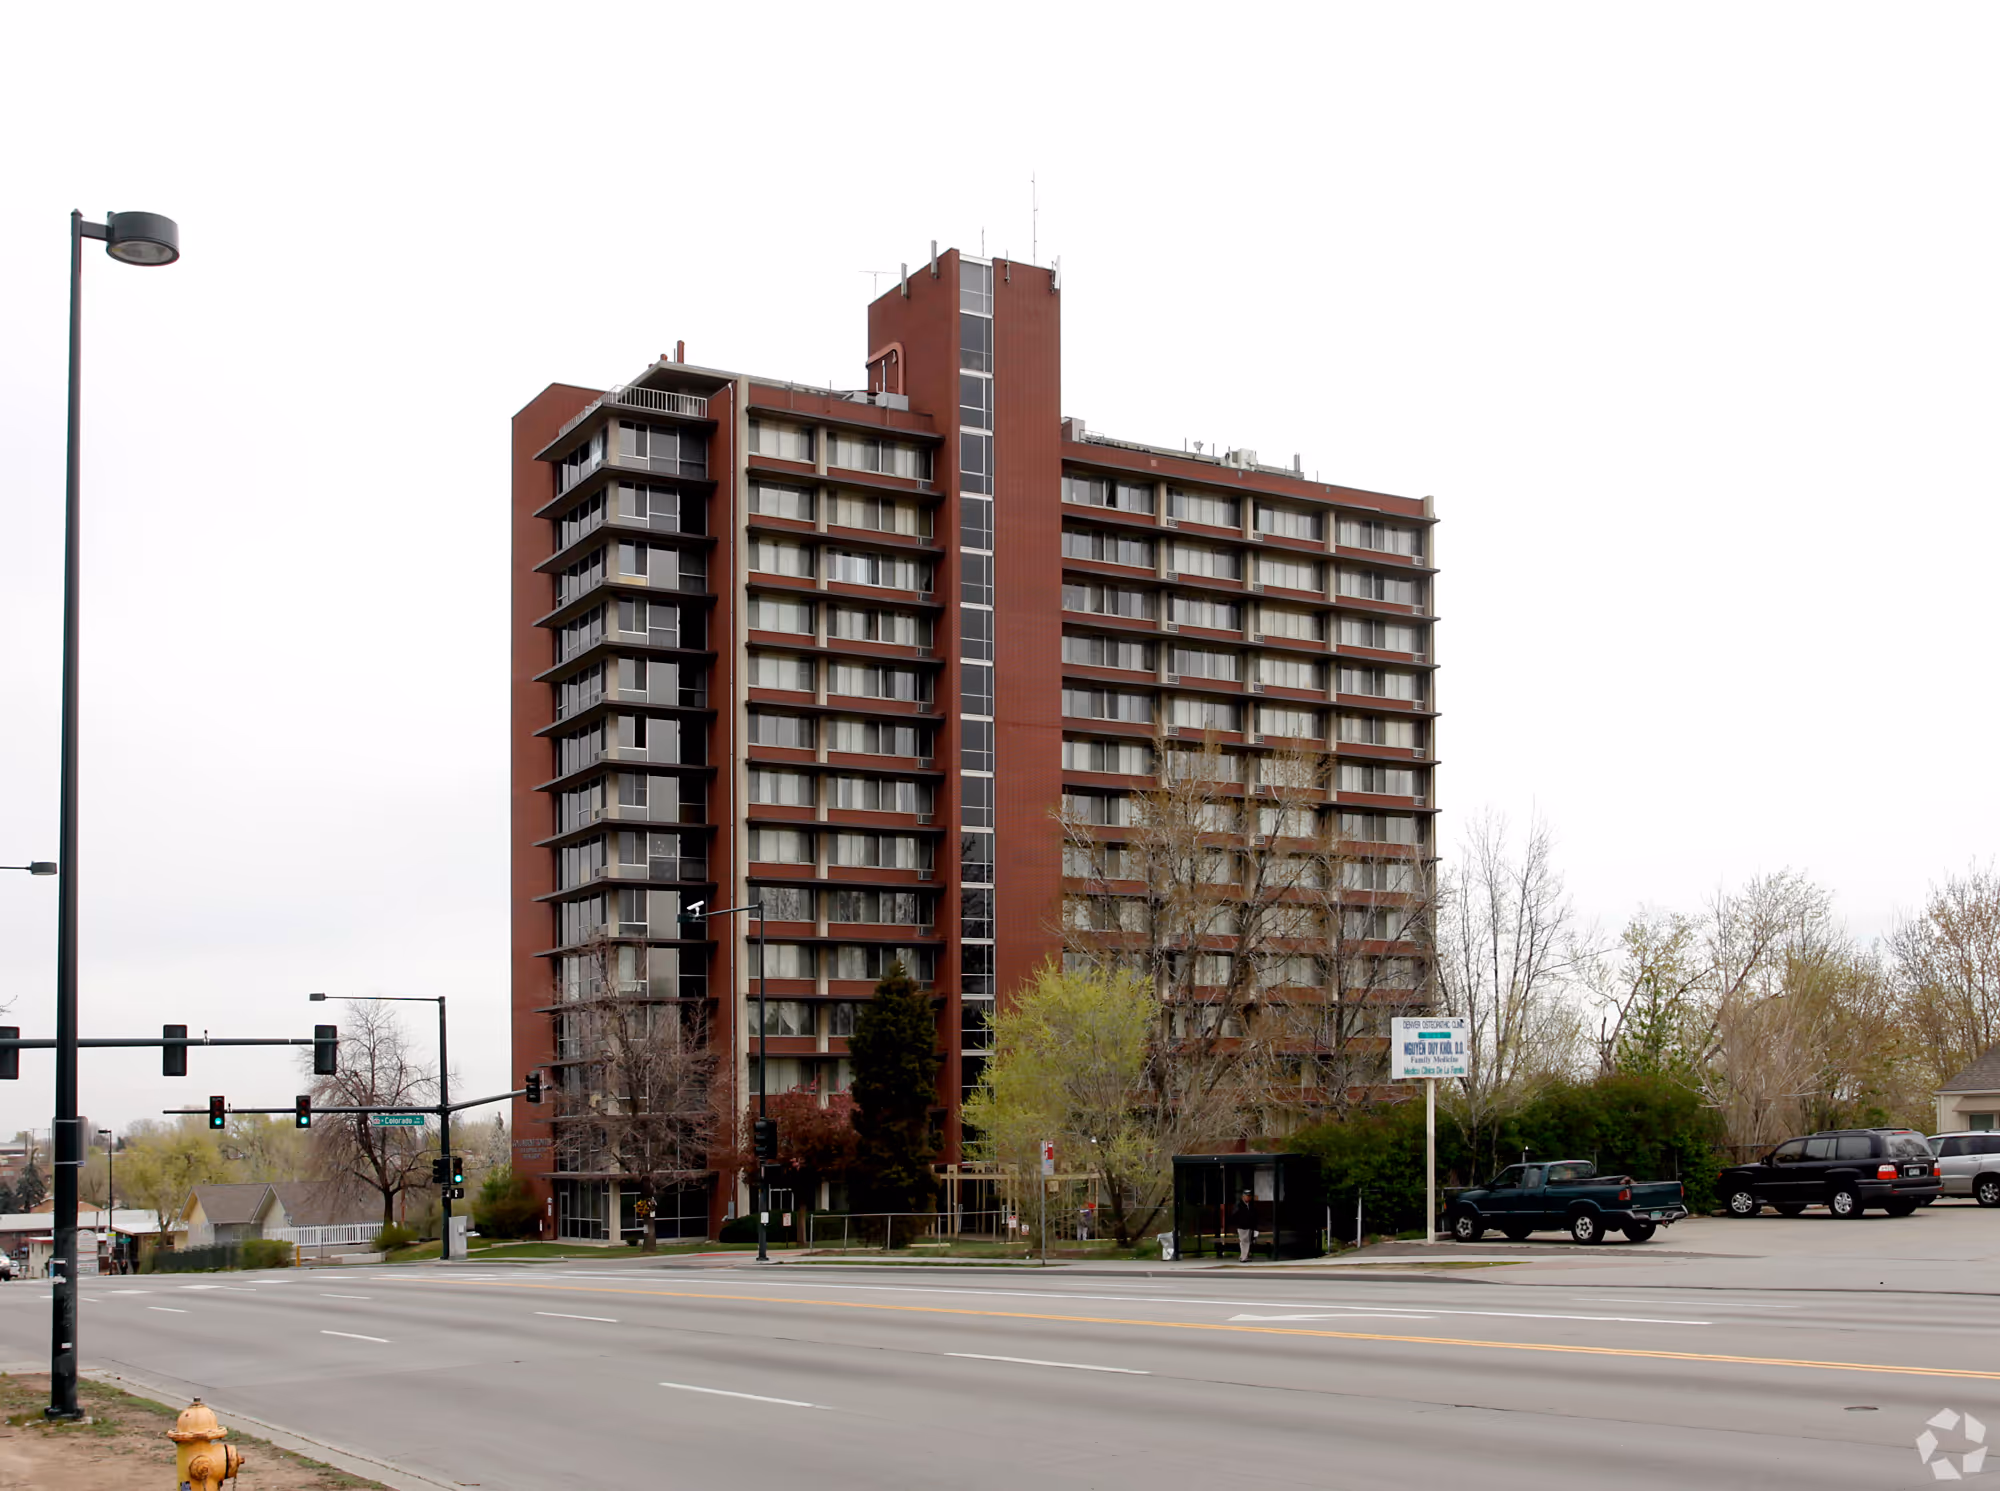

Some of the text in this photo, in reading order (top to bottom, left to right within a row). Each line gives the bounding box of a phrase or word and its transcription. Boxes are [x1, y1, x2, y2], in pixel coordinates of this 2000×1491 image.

[1403, 1020, 1421, 1029] DENVER
[1427, 1041, 1438, 1055] DUY
[1410, 1056, 1431, 1064] Family
